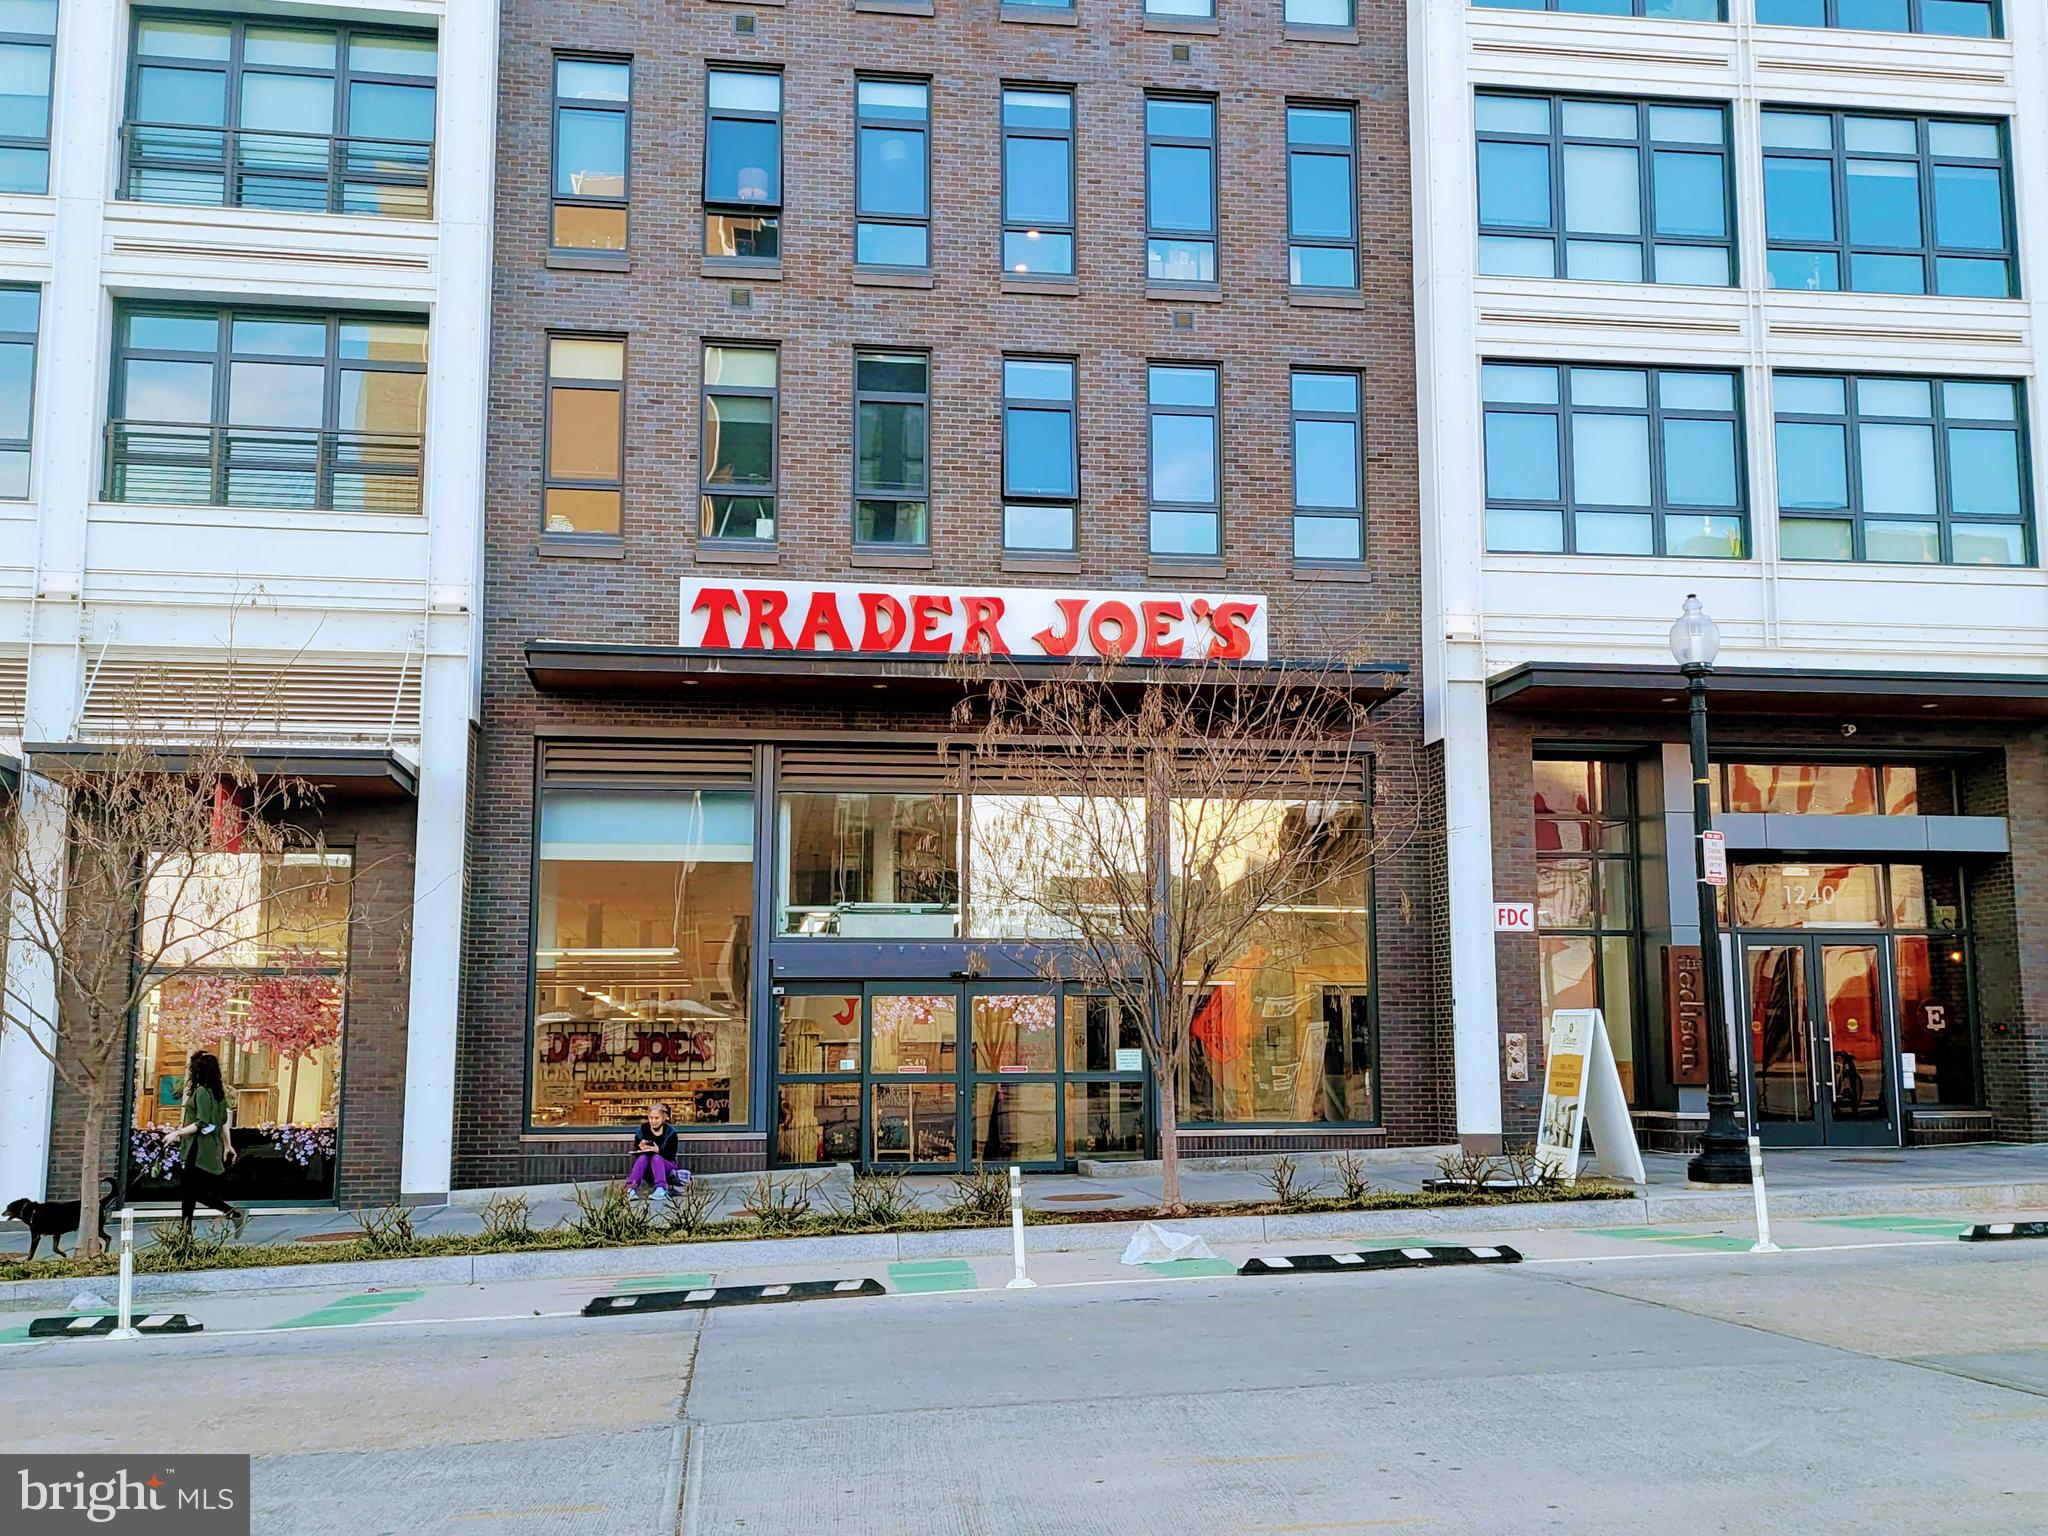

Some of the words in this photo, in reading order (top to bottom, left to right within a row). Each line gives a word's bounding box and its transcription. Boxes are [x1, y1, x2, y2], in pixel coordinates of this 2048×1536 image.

[690, 587, 1011, 656] TRADER
[1031, 596, 1259, 661] JOE'S
[1784, 885, 1836, 905] 1240
[1498, 908, 1529, 926] FDC
[1925, 1005, 1946, 1031] E
[587, 1063, 679, 1082] MARKET
